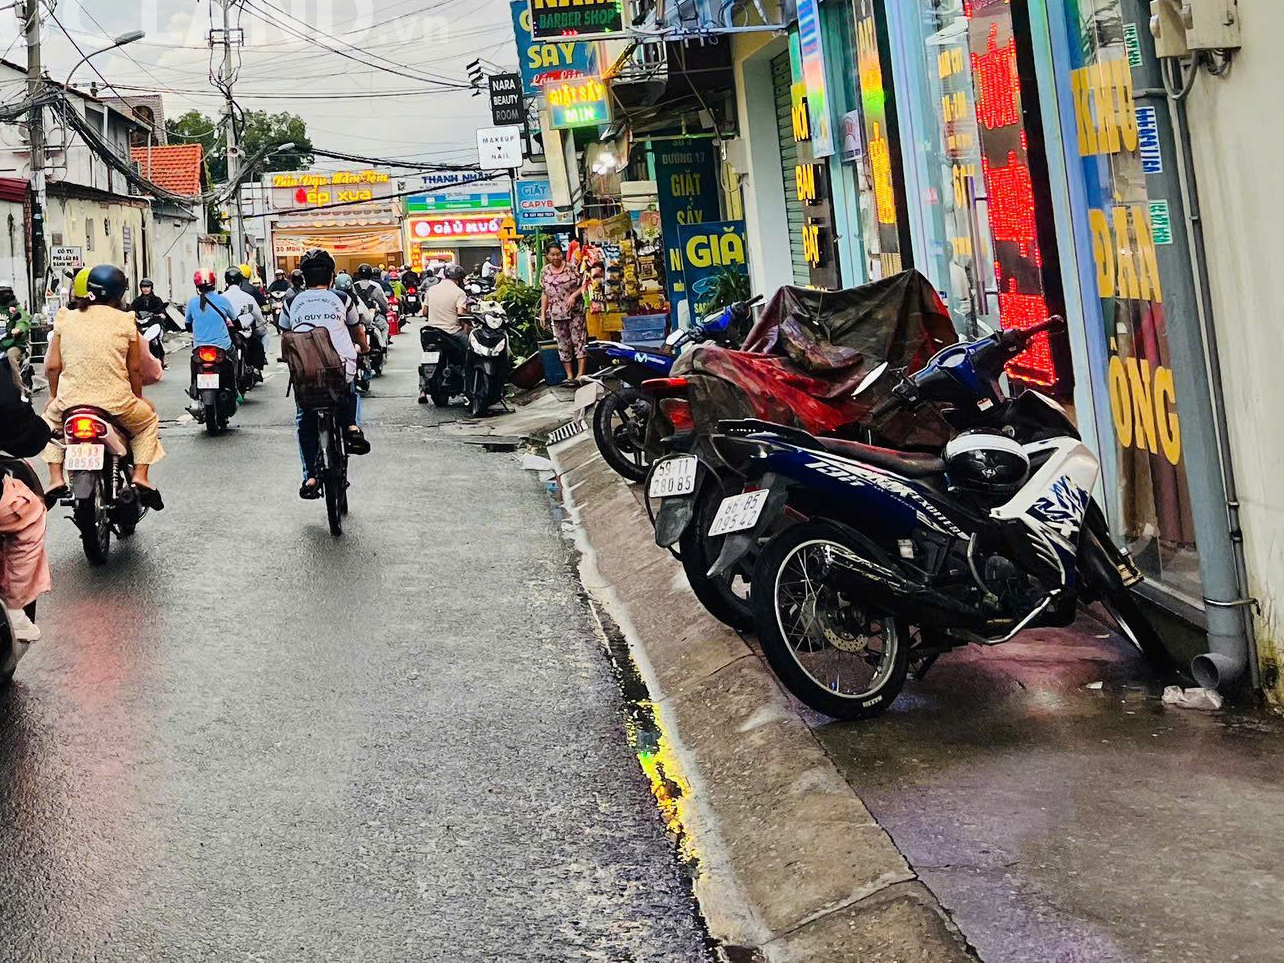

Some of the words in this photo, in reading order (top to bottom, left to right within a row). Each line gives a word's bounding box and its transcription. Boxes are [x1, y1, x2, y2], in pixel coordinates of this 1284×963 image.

[539, 10, 581, 28] BARBER
[584, 7, 616, 25] SHOP
[492, 79, 515, 91] NARA
[493, 94, 518, 106] BEAUTY
[1070, 59, 1137, 156] KHU
[496, 109, 519, 121] ROOM
[564, 106, 595, 124] MIN
[482, 136, 515, 144] MAKEUP
[422, 175, 458, 184] THANH
[1108, 340, 1181, 466] ÔNG
